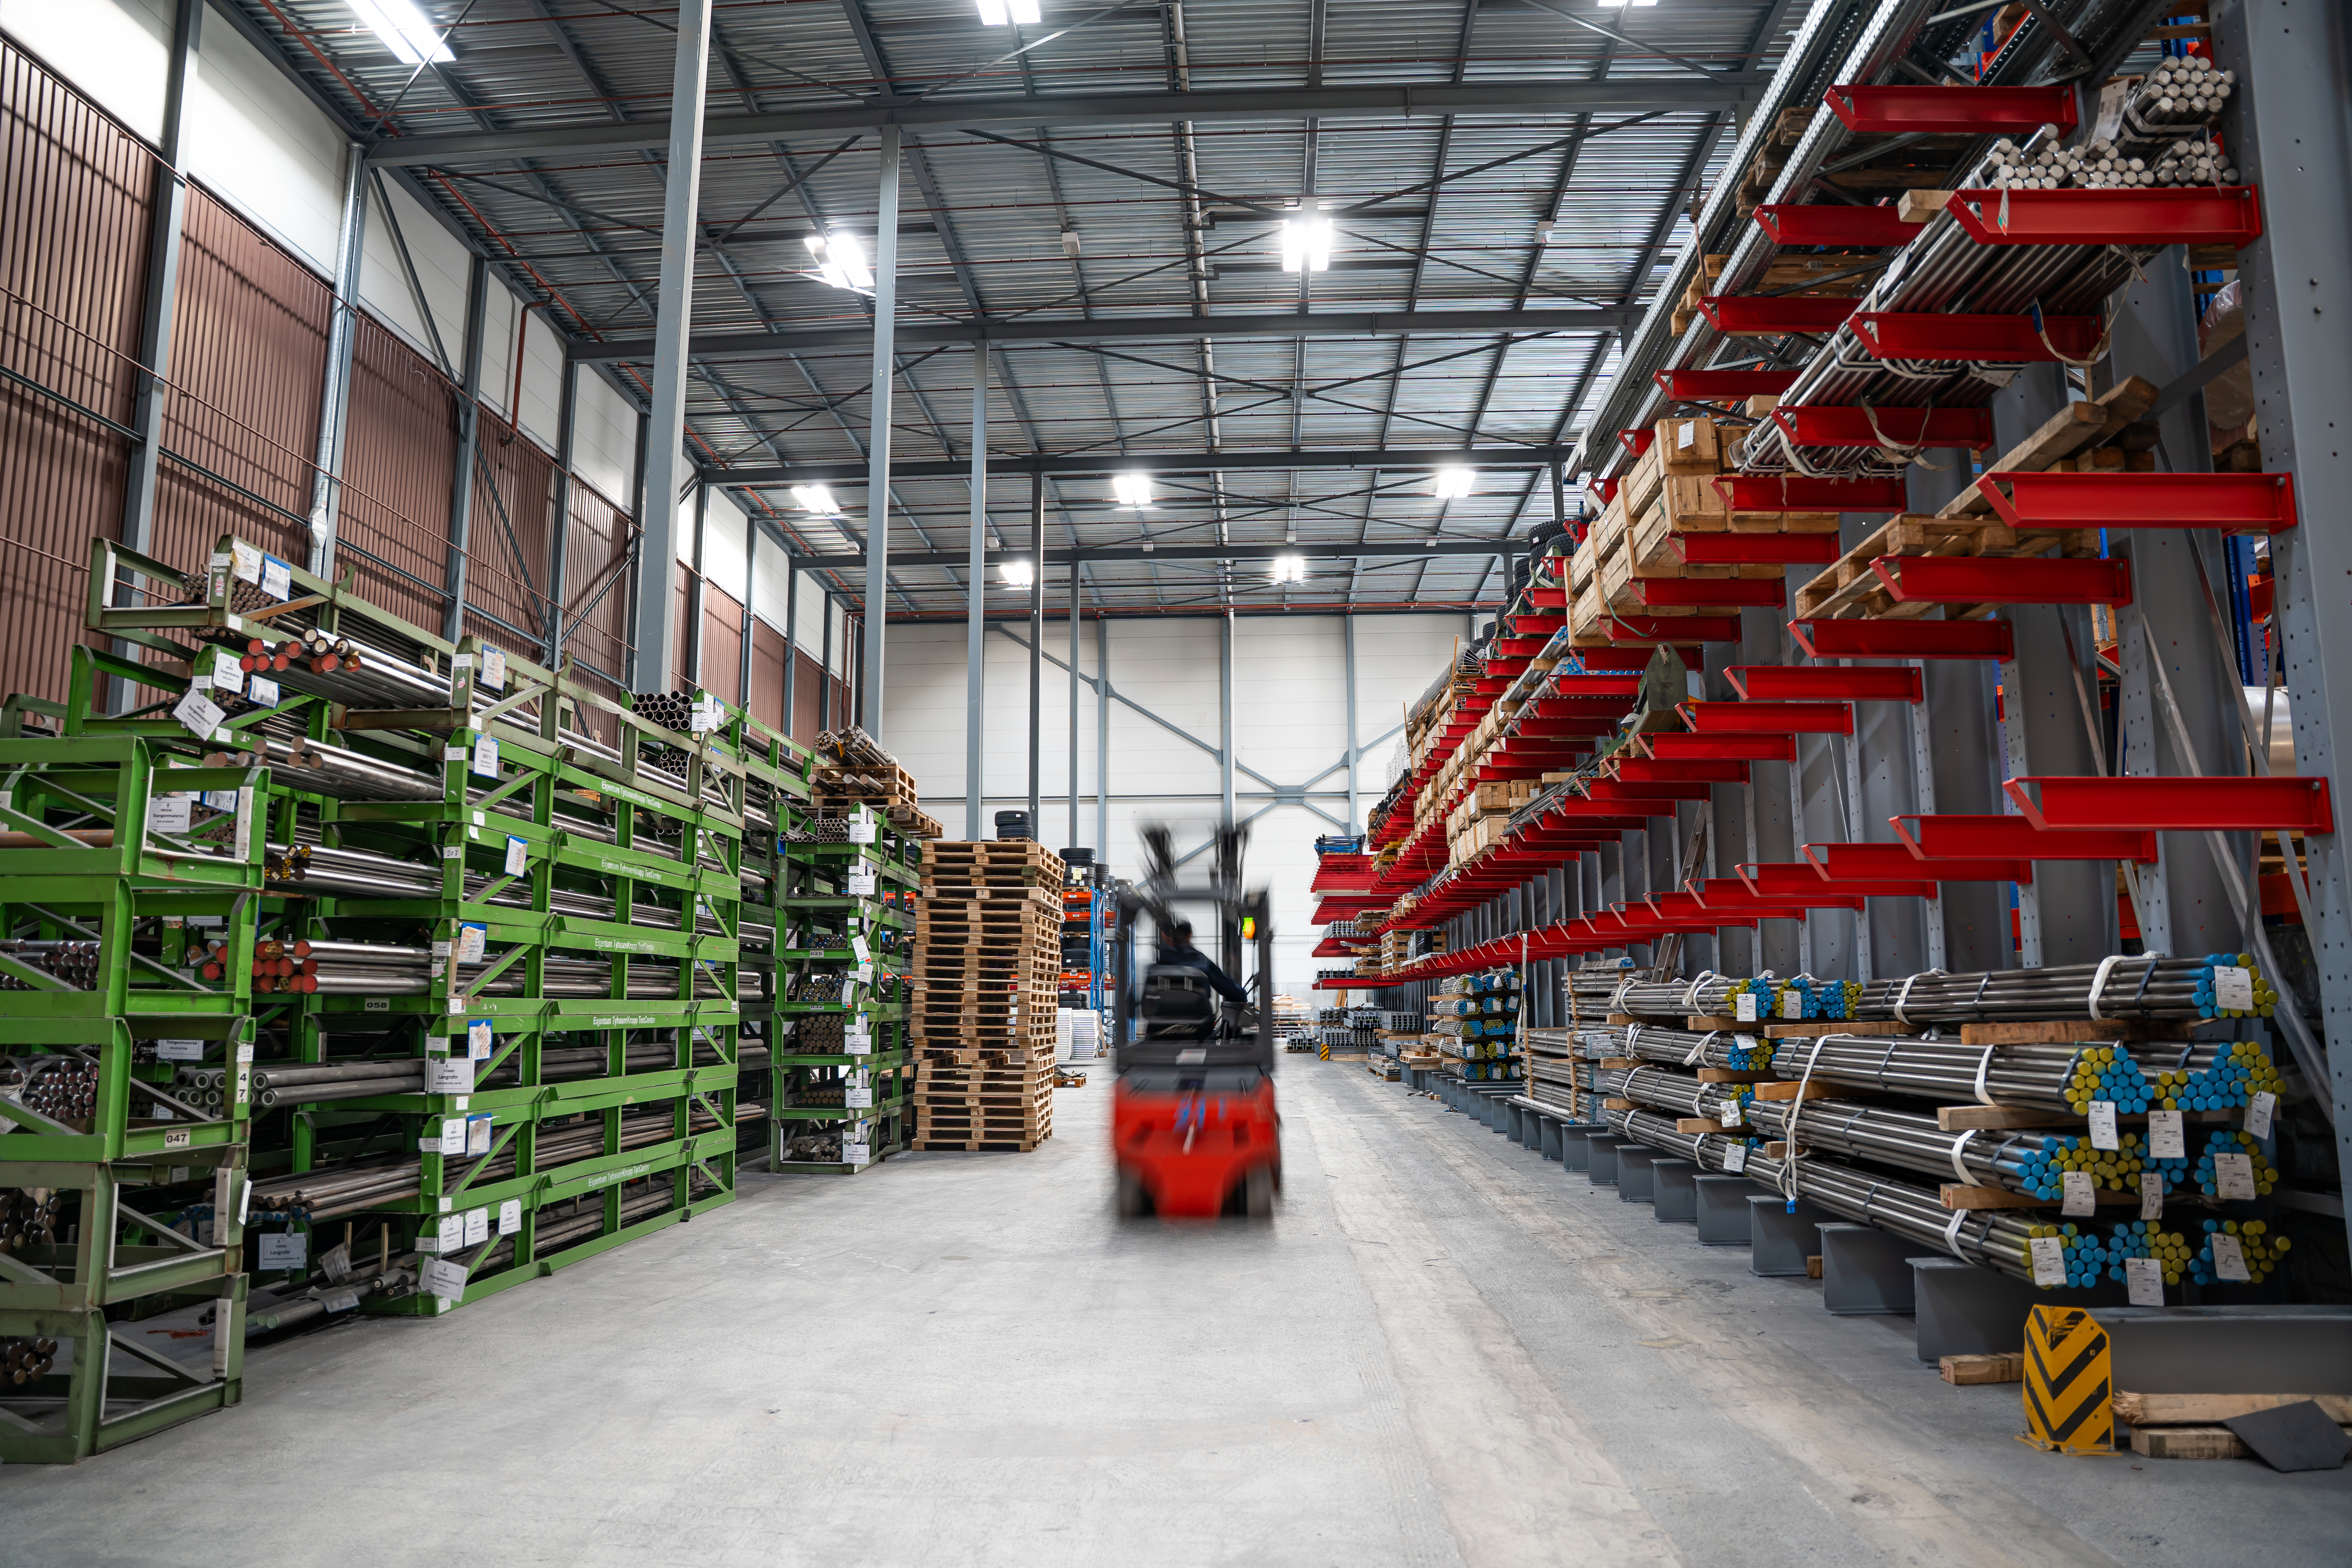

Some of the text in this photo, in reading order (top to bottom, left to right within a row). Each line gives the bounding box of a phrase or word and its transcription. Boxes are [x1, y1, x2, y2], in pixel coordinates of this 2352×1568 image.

[187, 704, 212, 726] Stangenmaterial
[601, 780, 620, 794] Eigentum
[646, 796, 662, 808] TecCenter
[601, 859, 619, 870] Eigentum
[645, 869, 661, 880] TecCenter
[595, 938, 613, 949] Eigentum
[638, 942, 654, 951] TecCenter
[593, 1016, 612, 1027] Eigentum
[166, 1134, 187, 1143] 047
[588, 1176, 607, 1188] Eigentum
[633, 1164, 650, 1174] TecCenter
[429, 1274, 461, 1286] Stangenmaterial
